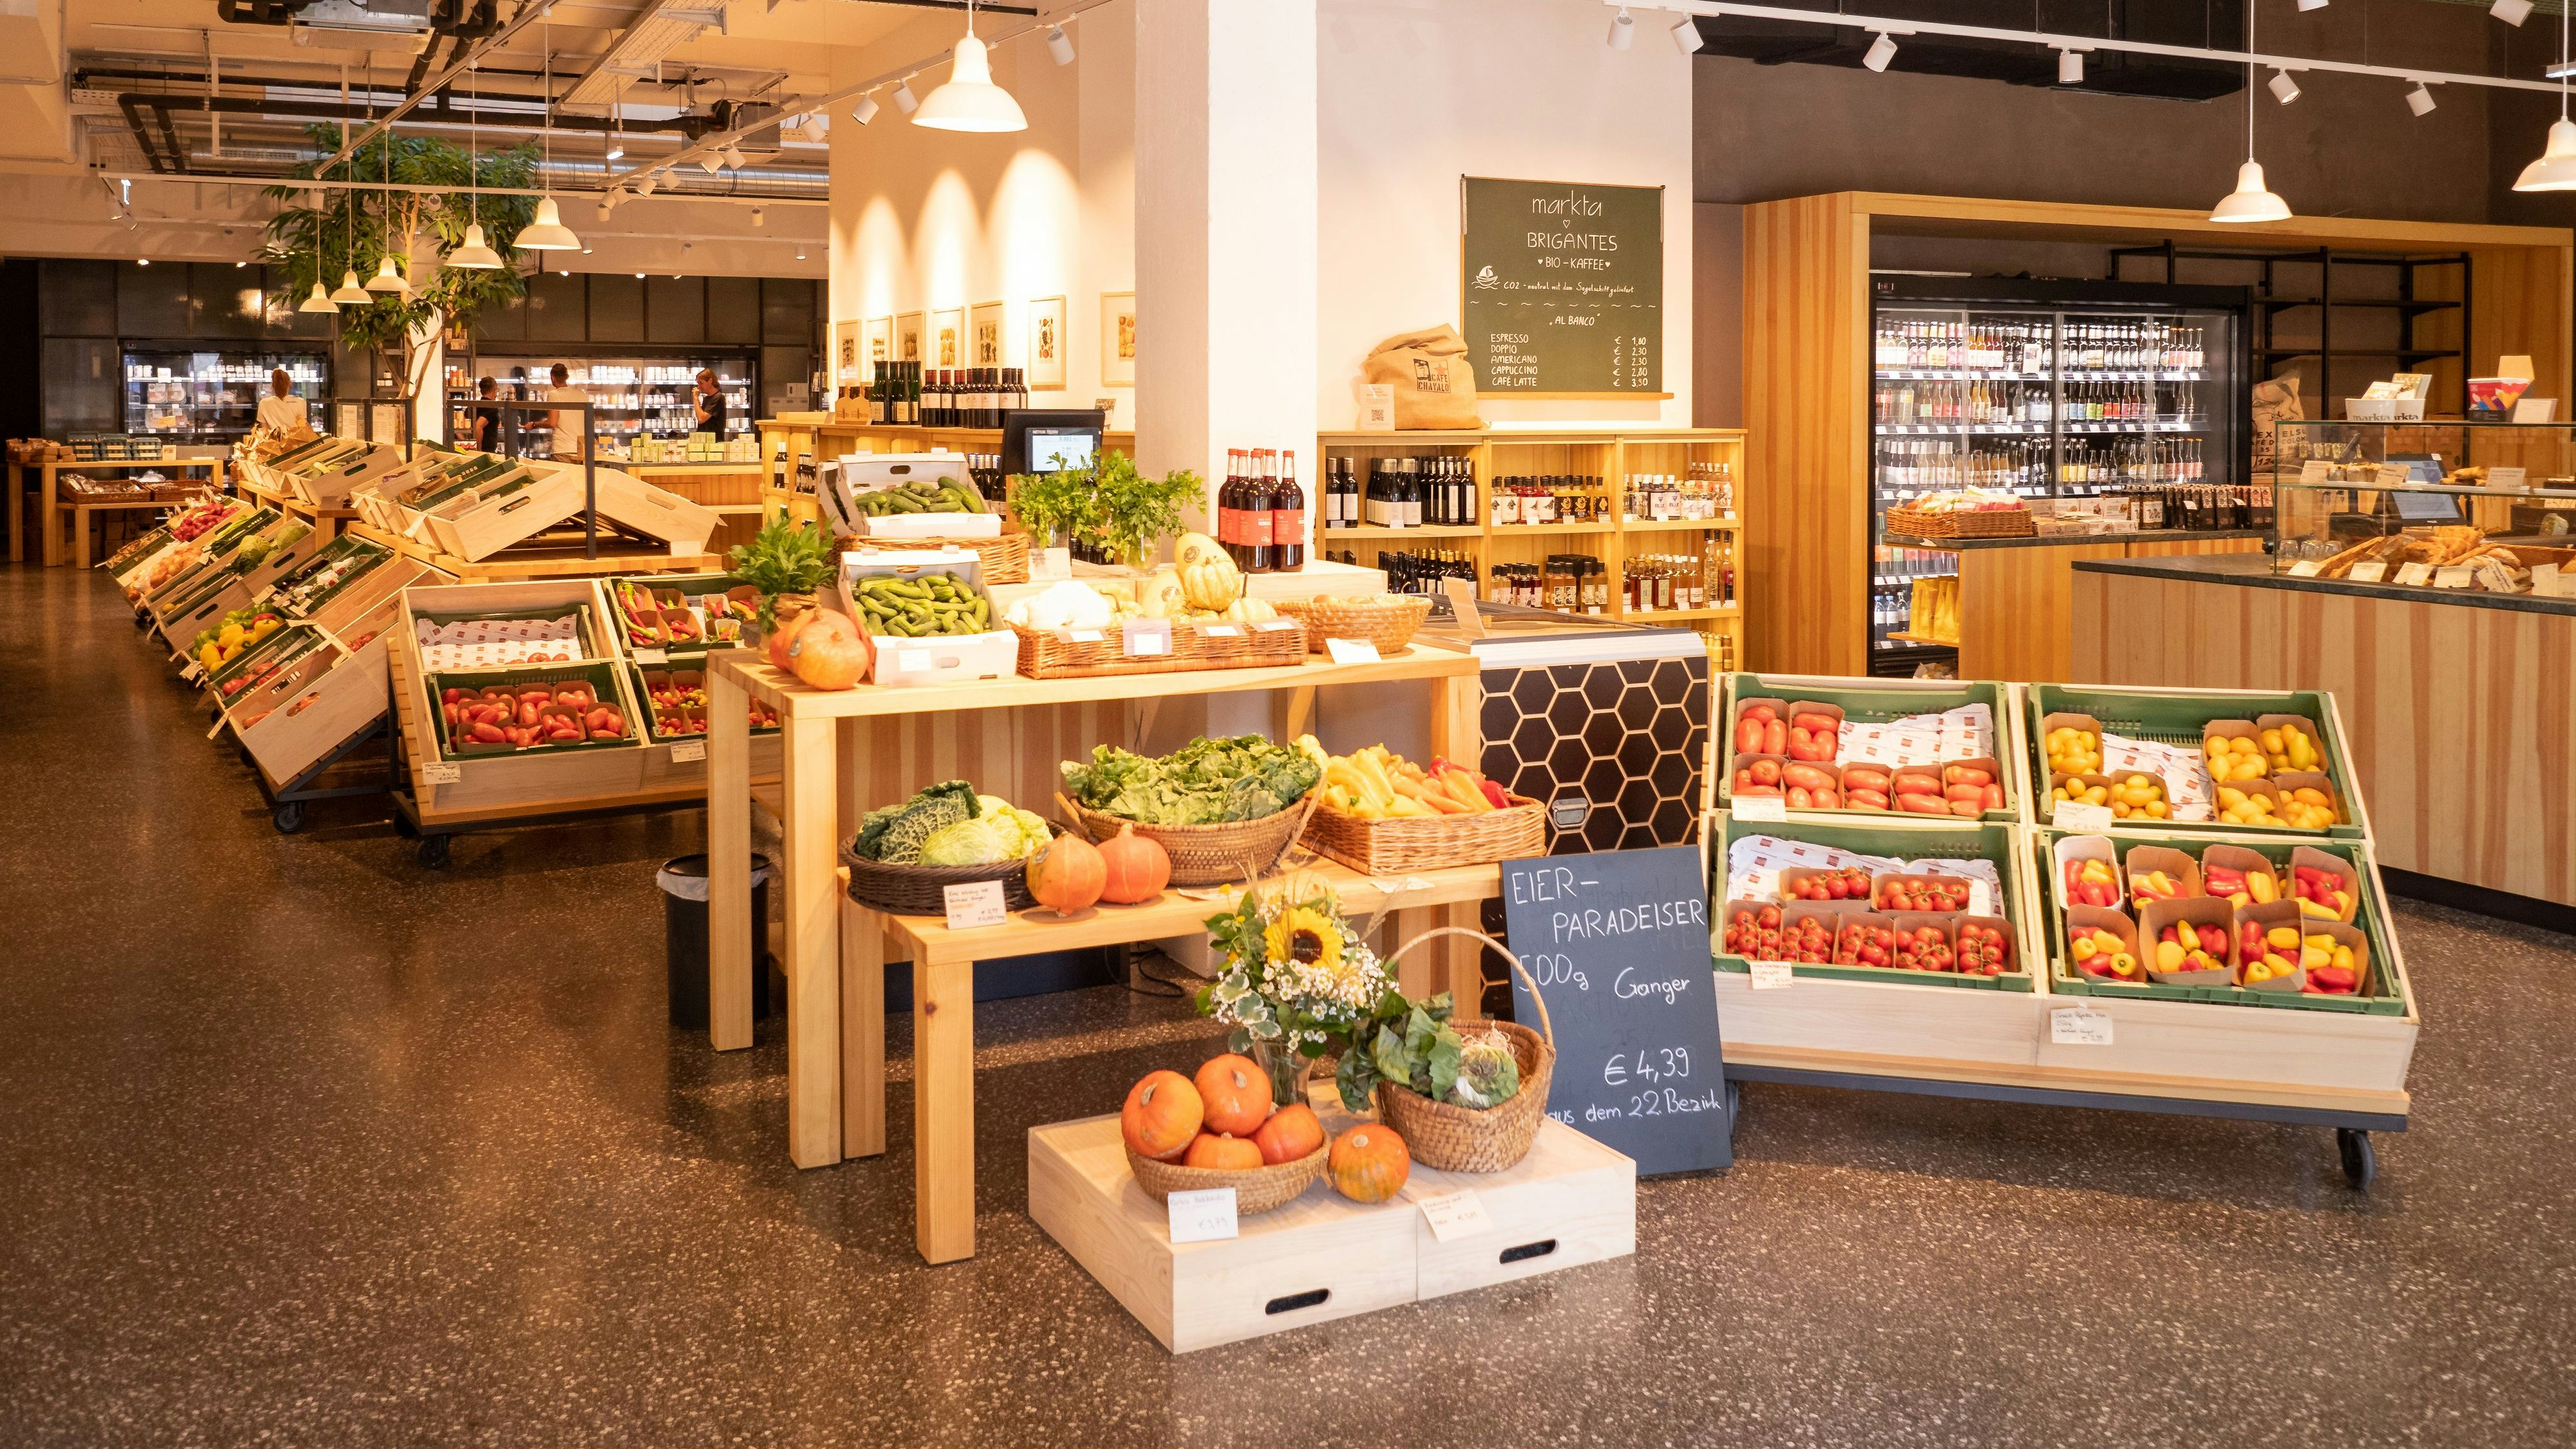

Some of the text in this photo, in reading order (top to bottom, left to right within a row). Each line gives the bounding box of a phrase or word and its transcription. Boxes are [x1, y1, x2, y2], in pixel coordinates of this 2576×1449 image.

[1533, 190, 1601, 216] markta
[1528, 232, 1617, 251] BRIGANTES
[1491, 334, 1528, 343] ESPRESSO
[1632, 337, 1646, 346] 1,80
[1492, 345, 1517, 354] DOPPIO
[1614, 346, 1646, 356] € 2,30
[1491, 355, 1537, 364] AMERICANO
[1614, 357, 1620, 365] €
[1492, 366, 1537, 375] CAPPUCCINO
[1632, 368, 1647, 377] 2,80
[1492, 376, 1537, 386] CAFÉ LATTE
[1512, 867, 1598, 904] EIER-
[1553, 898, 1705, 943] PARADEISER
[1615, 967, 1689, 1004] Ganger
[1605, 1048, 1689, 1085] € 4,39
[1586, 1104, 1621, 1122] dem
